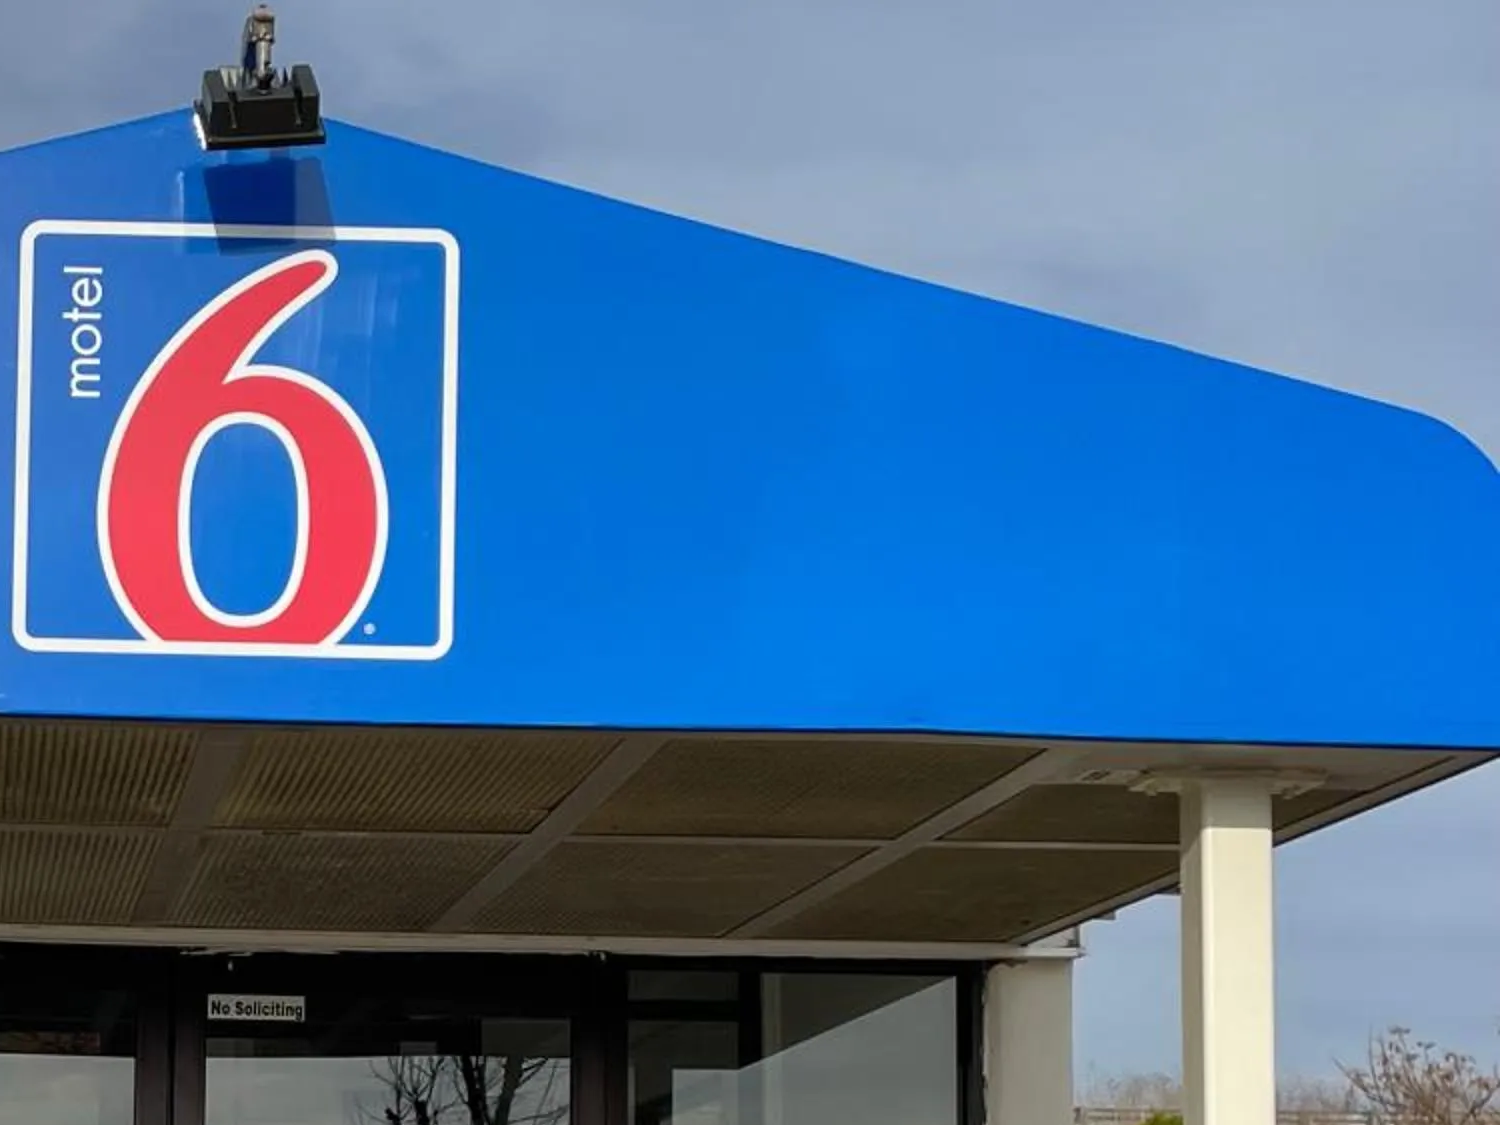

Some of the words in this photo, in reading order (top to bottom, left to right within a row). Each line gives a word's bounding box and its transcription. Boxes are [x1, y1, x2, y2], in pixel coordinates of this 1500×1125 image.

[62, 265, 103, 398] motel
[97, 249, 388, 646] 6
[211, 1000, 231, 1017] No
[235, 1000, 303, 1021] Soliciting
